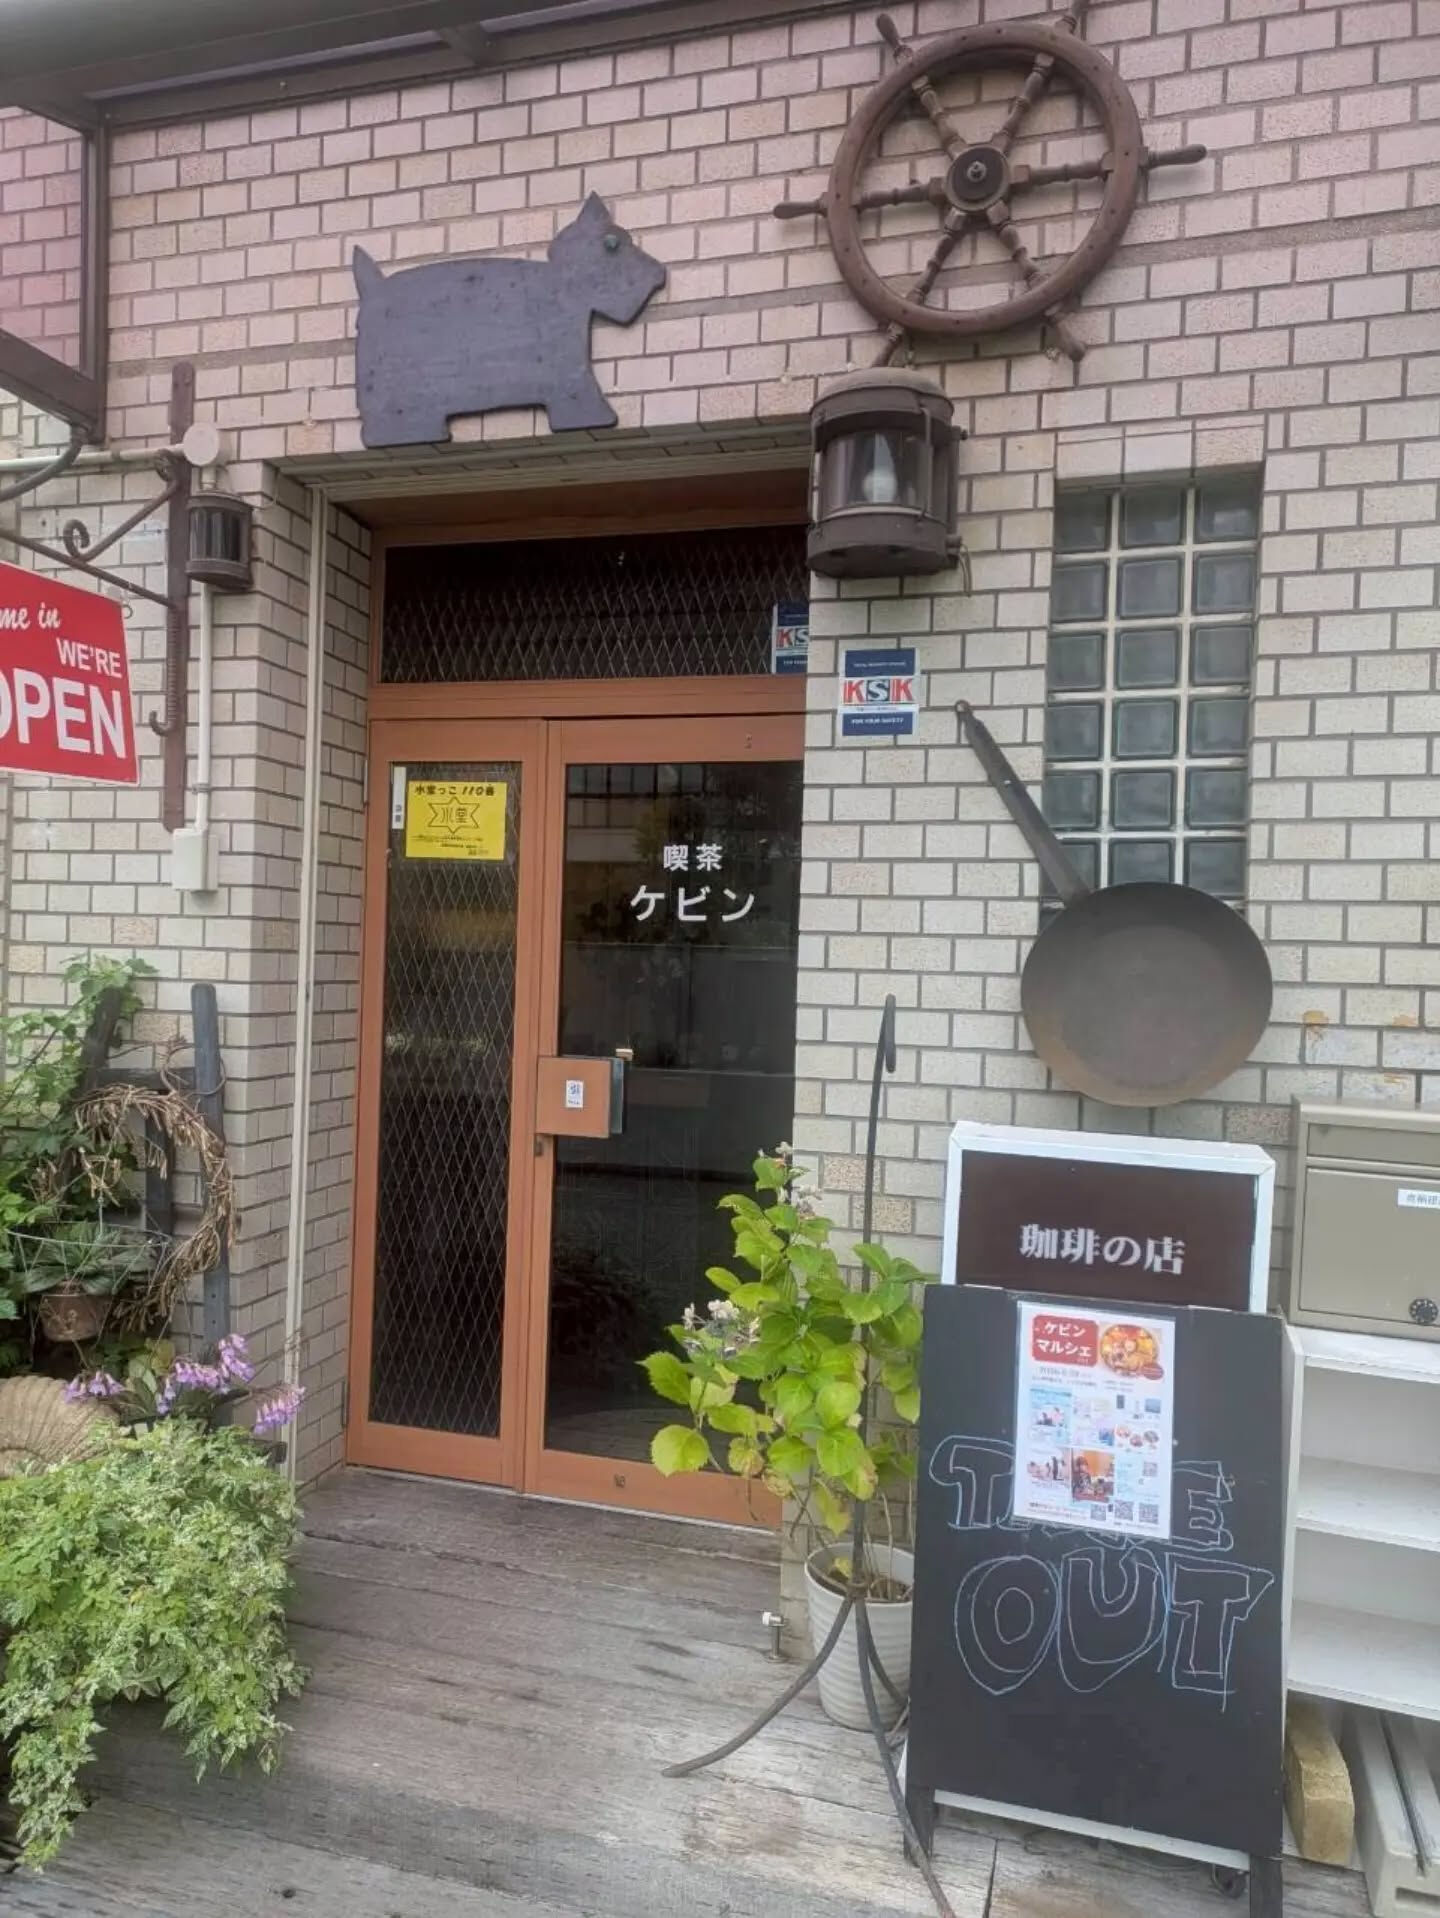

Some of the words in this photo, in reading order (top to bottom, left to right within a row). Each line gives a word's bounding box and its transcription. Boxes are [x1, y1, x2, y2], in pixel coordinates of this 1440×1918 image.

[37, 601, 61, 630] in
[56, 637, 122, 678] WE'RE
[844, 678, 913, 703] KSK
[663, 843, 722, 872] 喫茶
[630, 885, 755, 922] ケビン
[1019, 1223, 1186, 1275] 珈琲の店
[1035, 1338, 1092, 1358] マルシェ
[955, 1547, 1275, 1712] OUT
